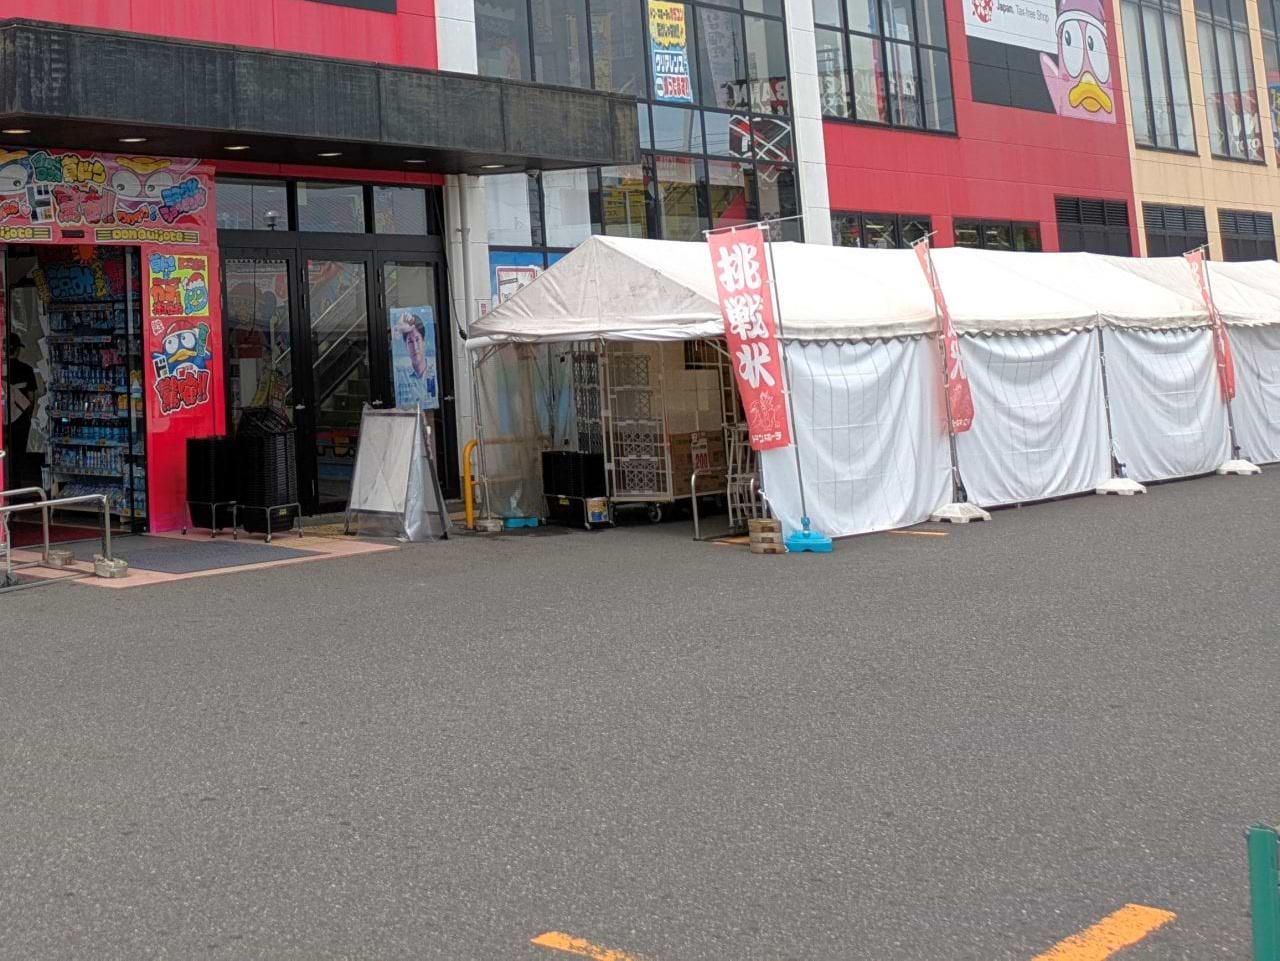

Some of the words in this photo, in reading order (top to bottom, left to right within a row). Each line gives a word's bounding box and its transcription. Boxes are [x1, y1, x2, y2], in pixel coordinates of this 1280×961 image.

[1036, 9, 1050, 23] Shop
[717, 242, 776, 389] 挑戦状
